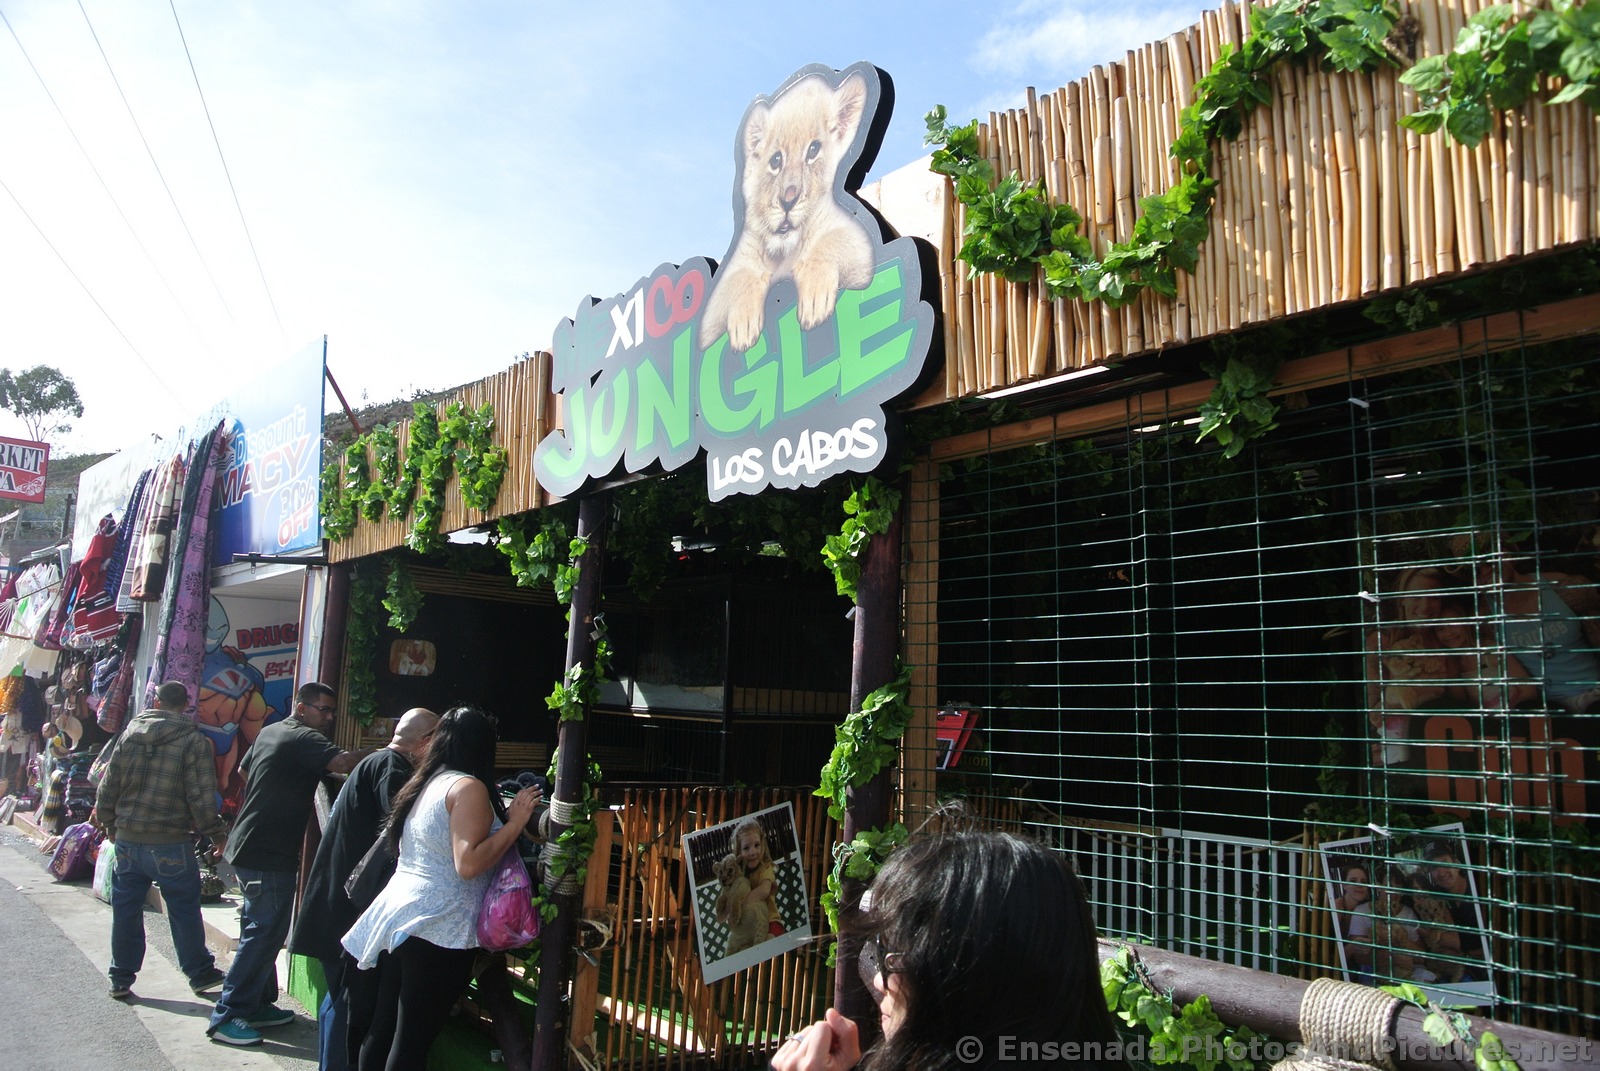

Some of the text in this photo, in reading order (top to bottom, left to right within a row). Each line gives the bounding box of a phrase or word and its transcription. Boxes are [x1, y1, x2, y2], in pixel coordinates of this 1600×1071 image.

[556, 268, 705, 384] MEXICO
[541, 262, 915, 478] JUNGLE
[236, 404, 307, 466] Discount
[712, 417, 879, 491] LOS CABOS
[278, 501, 314, 547] OFF
